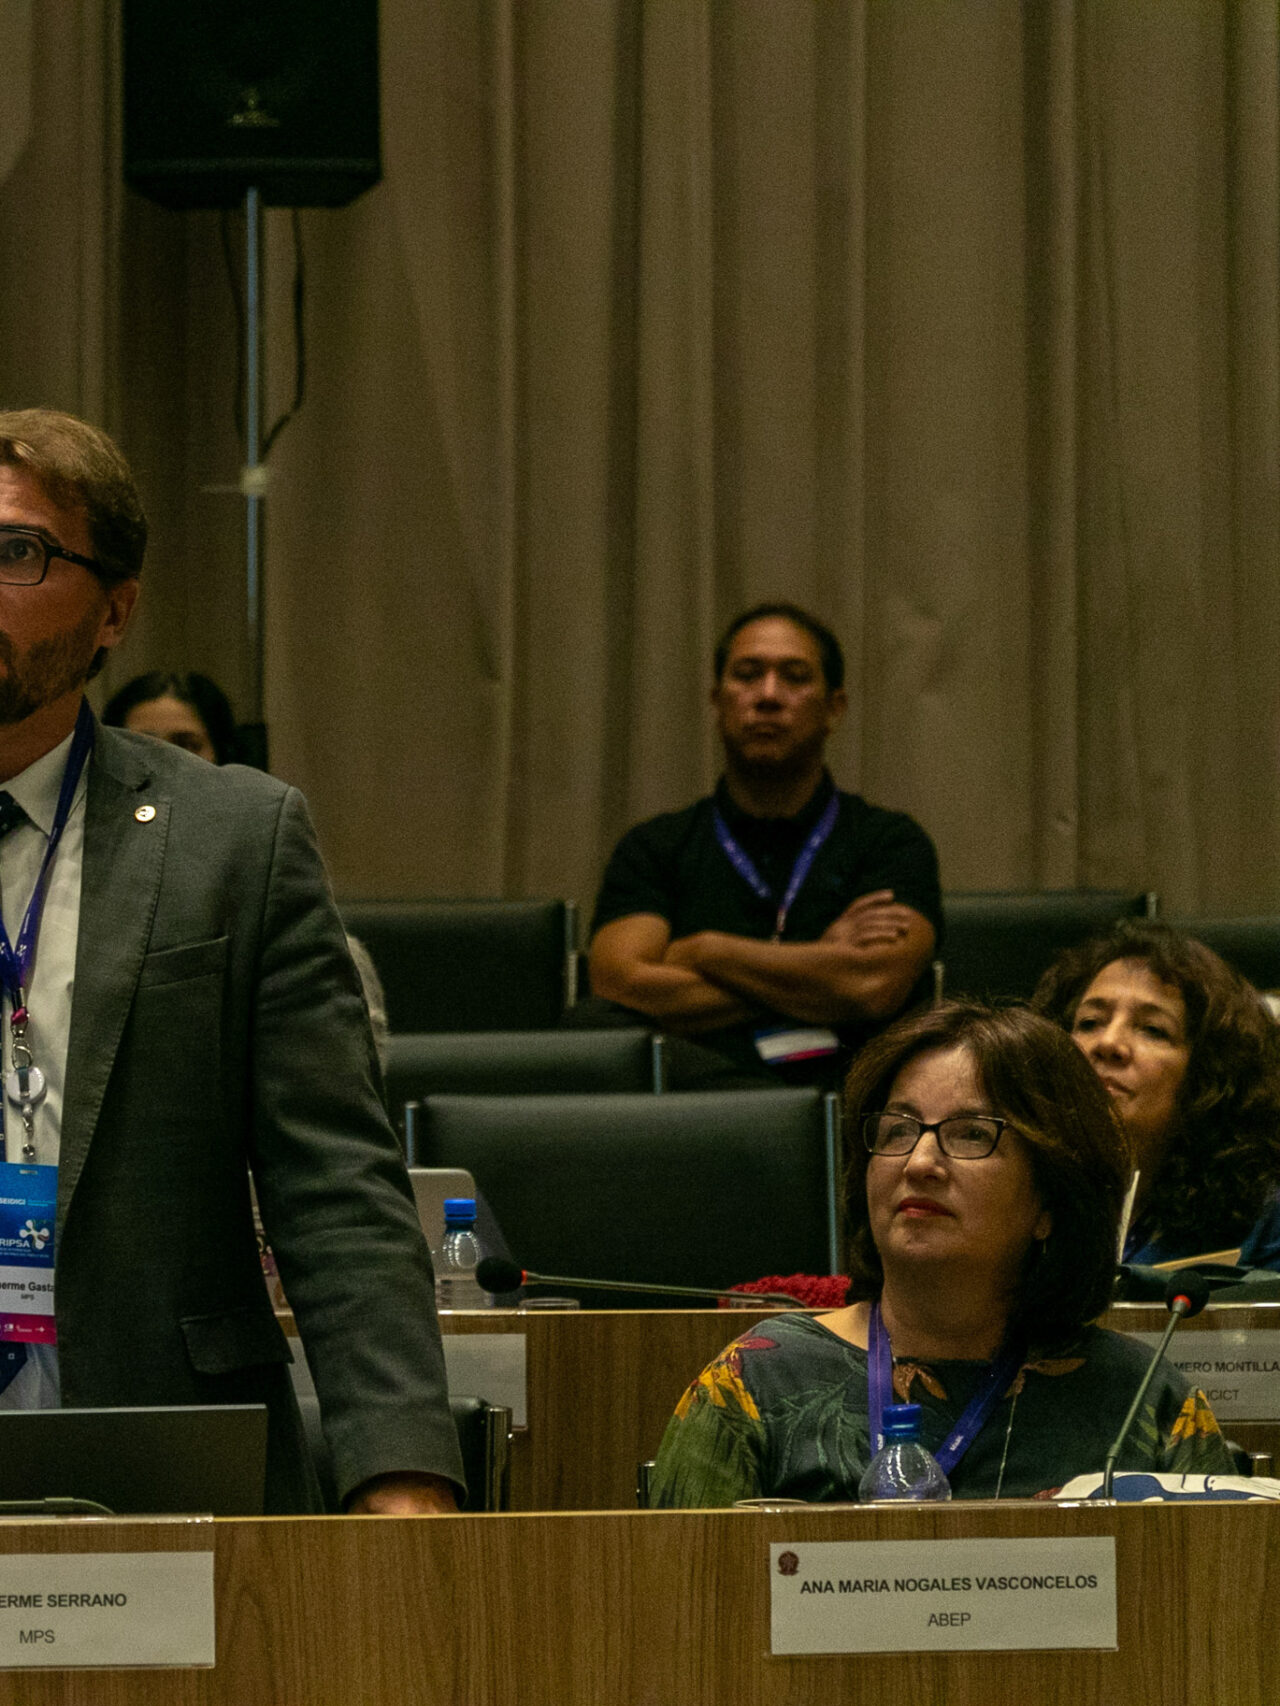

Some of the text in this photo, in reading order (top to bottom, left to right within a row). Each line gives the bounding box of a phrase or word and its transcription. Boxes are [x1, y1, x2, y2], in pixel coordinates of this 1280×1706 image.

[1215, 1360, 1280, 1373] MONTILLA
[800, 1574, 1098, 1594] ANA MARIA NOGALES VASCONCELOS
[46, 1593, 127, 1608] SERRANO
[928, 1611, 972, 1627] ABEP
[19, 1629, 55, 1644] MPS
